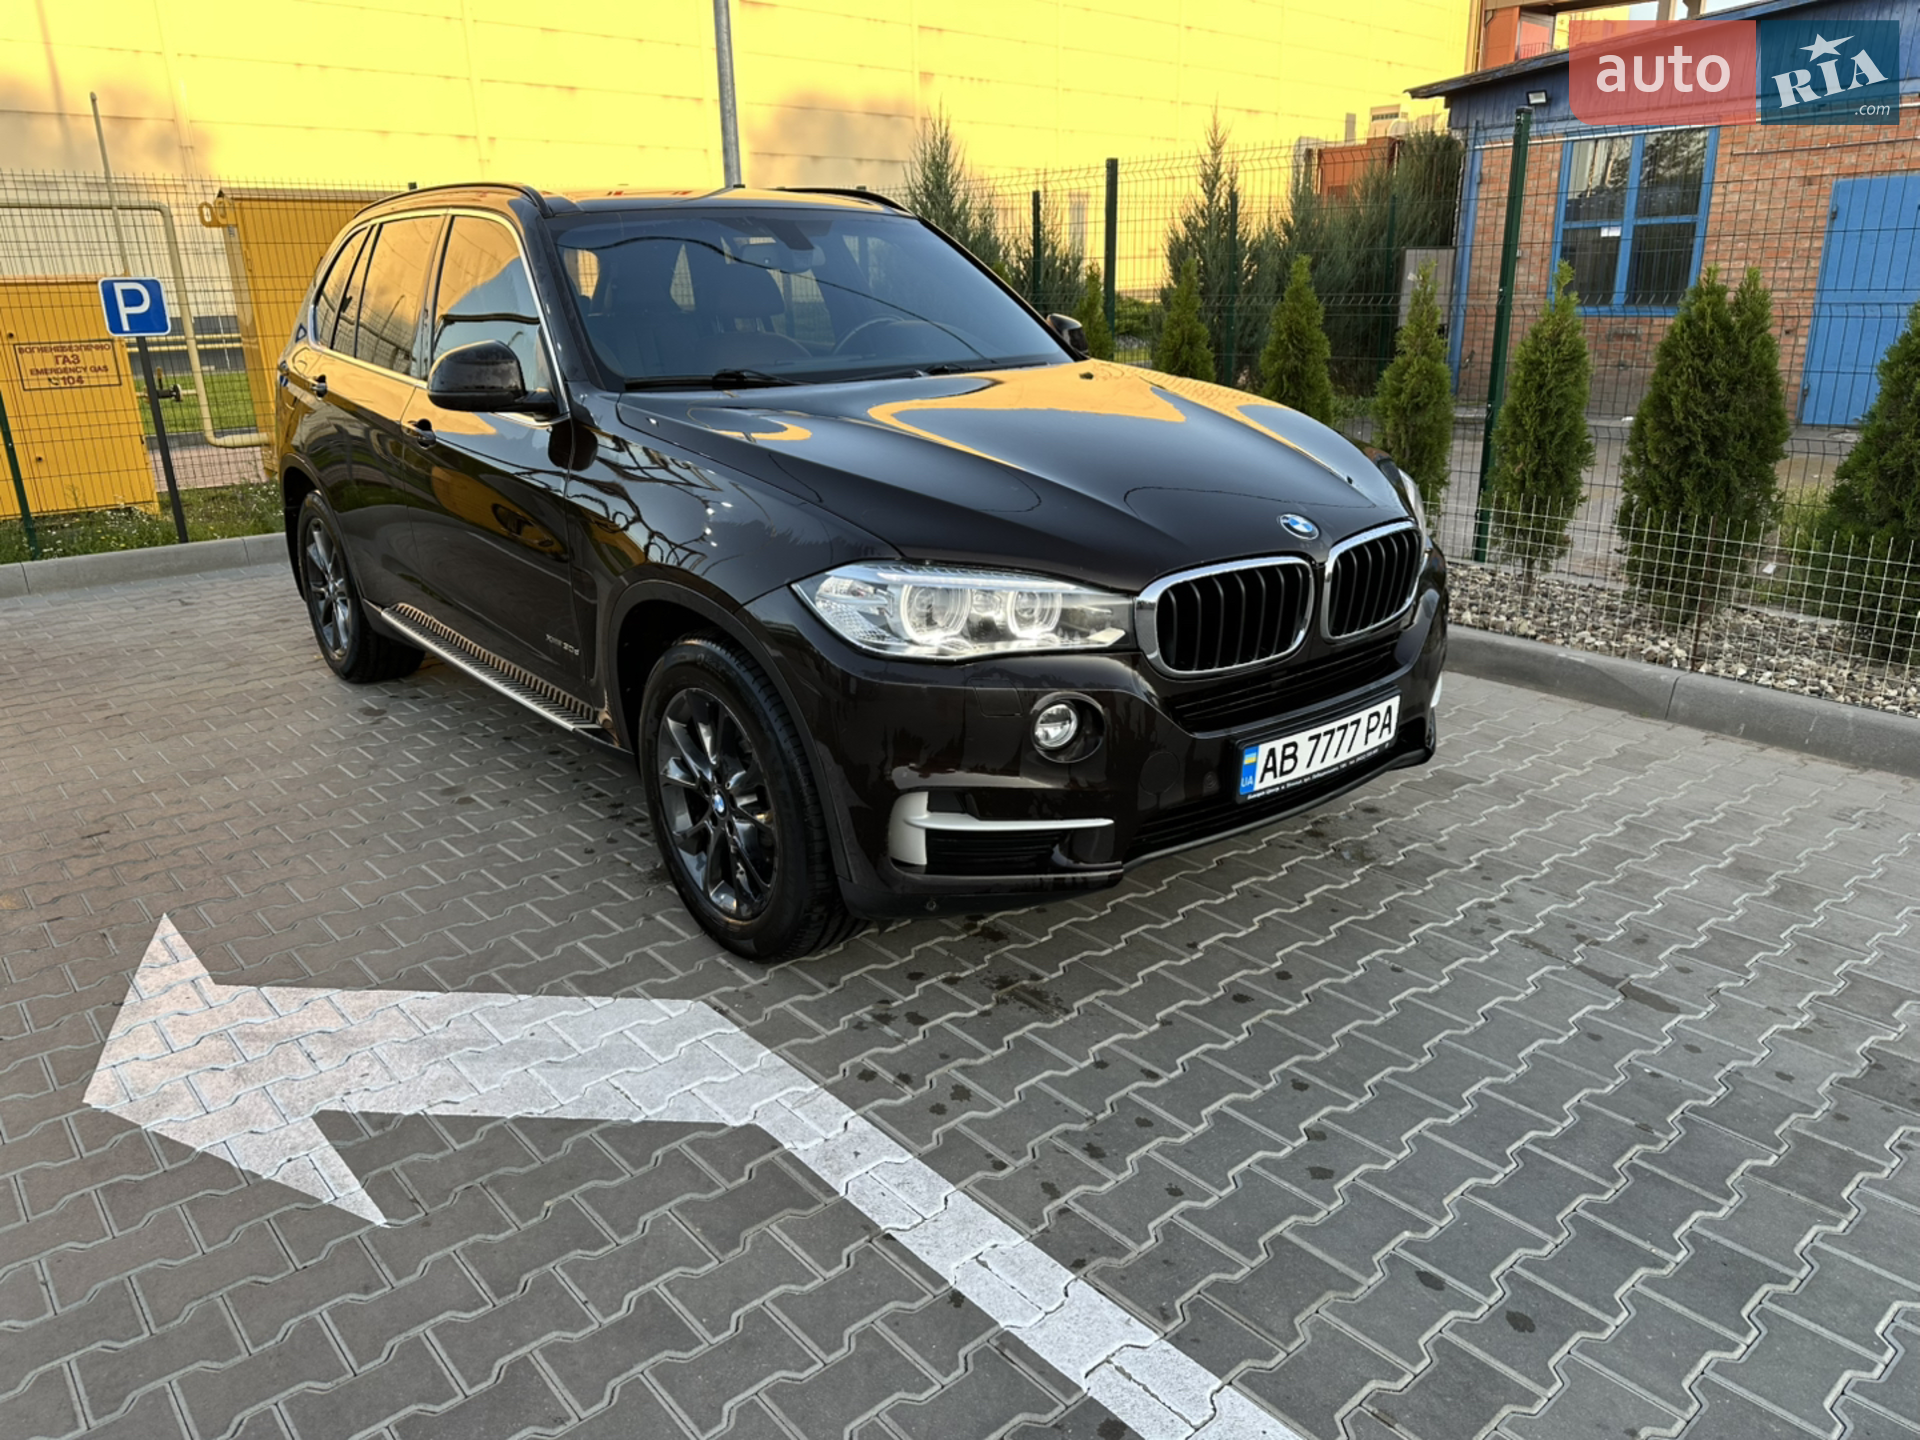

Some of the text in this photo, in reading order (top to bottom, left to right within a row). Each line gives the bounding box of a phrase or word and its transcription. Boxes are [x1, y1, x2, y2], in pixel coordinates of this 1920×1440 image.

[113, 282, 151, 331] P
[55, 354, 81, 365] ГАЗ
[30, 365, 109, 376] EMERGENCY GAS
[61, 376, 85, 386] 104
[1259, 705, 1392, 783] AB 7777 PA
[1241, 776, 1254, 787] UA
